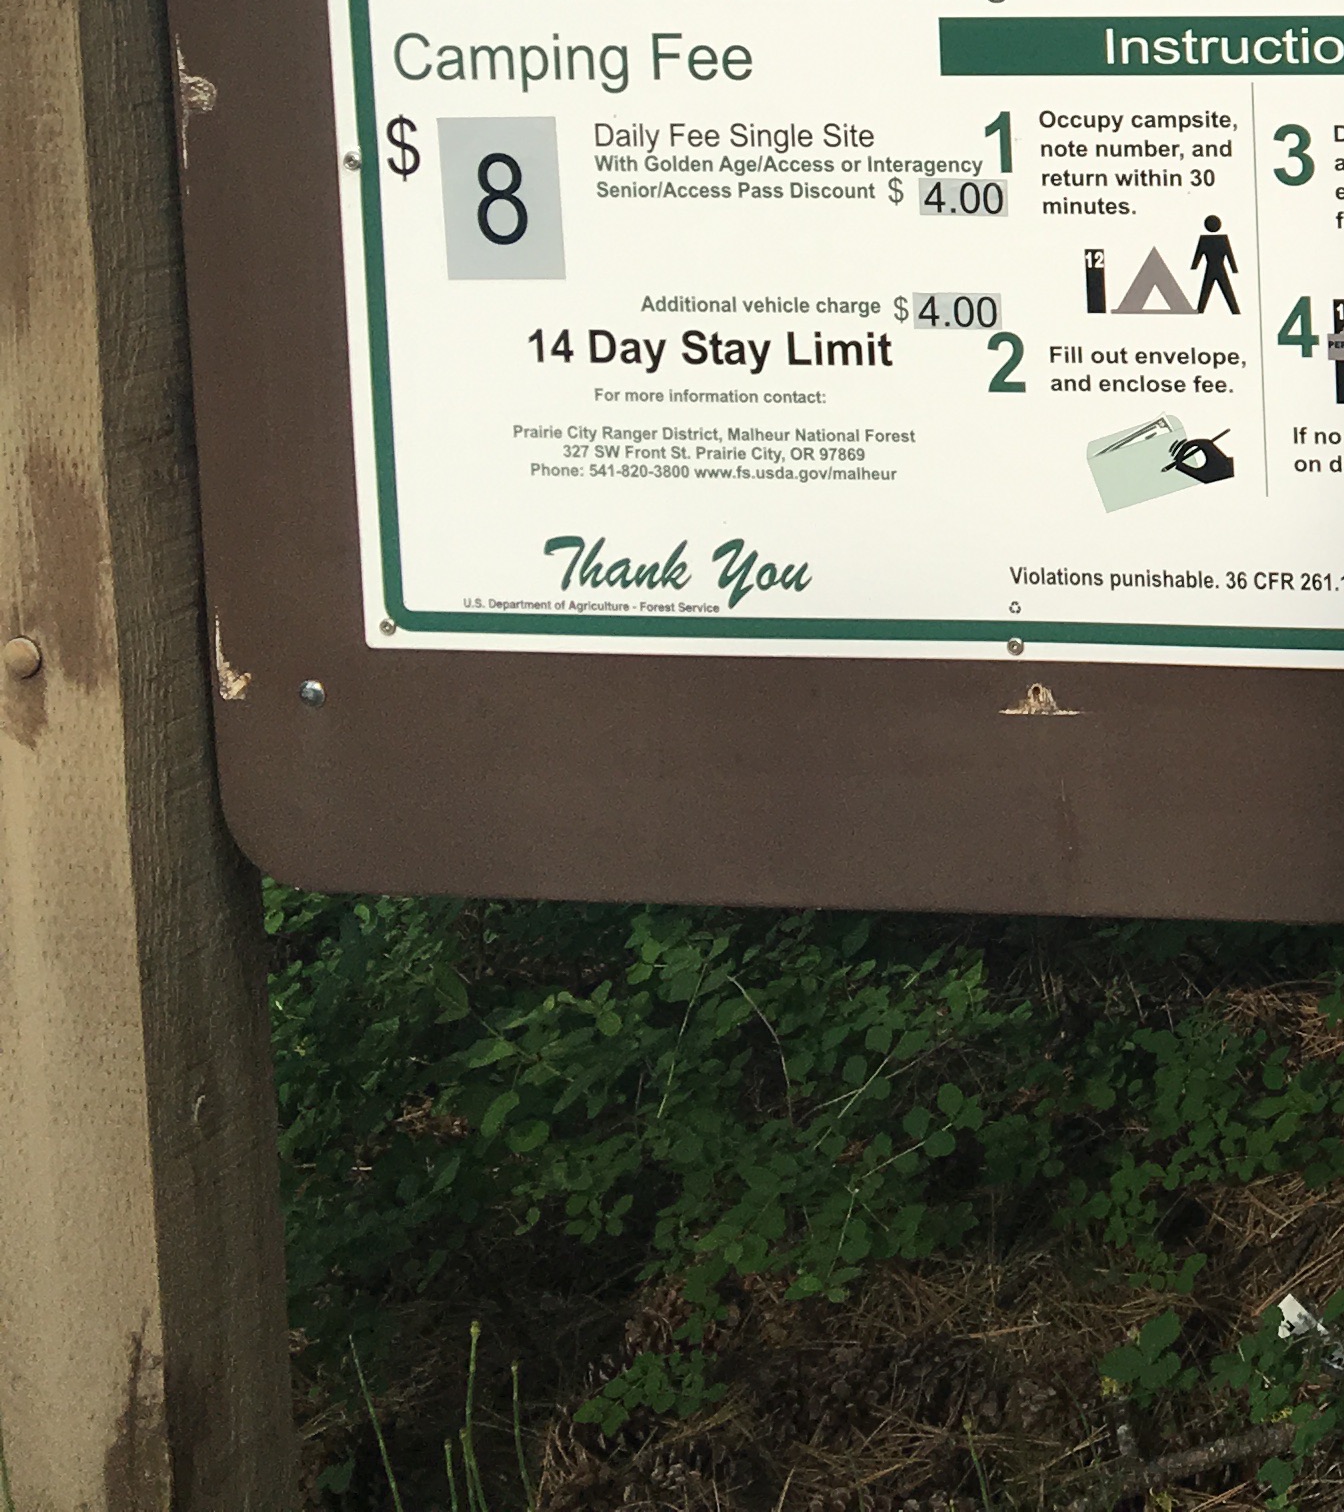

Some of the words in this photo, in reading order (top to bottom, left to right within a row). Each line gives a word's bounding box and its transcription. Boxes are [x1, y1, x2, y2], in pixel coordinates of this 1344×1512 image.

[393, 32, 629, 94] Camping
[651, 32, 753, 82] Fee
[1038, 109, 1124, 134] Occupy
[1130, 109, 1238, 133] campsite,
[385, 113, 421, 183] $
[984, 110, 1014, 174] 1
[1040, 140, 1089, 158] note
[1095, 139, 1185, 161] number,
[1191, 139, 1233, 158] and
[593, 154, 638, 172] With
[644, 154, 714, 173] Golden
[718, 154, 835, 177] Age/Access
[840, 159, 862, 173] or
[867, 155, 984, 180] Interagency
[1041, 169, 1108, 187] return
[1114, 168, 1183, 187] within
[1189, 168, 1216, 188] 30
[476, 152, 529, 246] 8
[596, 180, 733, 203] Senior/Access
[736, 180, 782, 200] Pass
[789, 180, 877, 200] Discount
[887, 177, 905, 206] $
[923, 182, 1004, 215] 4.00
[1042, 196, 1137, 216] minutes.
[1084, 249, 1105, 271] 12
[986, 331, 1027, 394] 2
[1049, 345, 1083, 364] Fill
[1090, 347, 1129, 365] out
[1134, 346, 1247, 370] envelope,
[594, 387, 621, 402] For
[624, 391, 665, 403] more
[668, 388, 759, 404] information
[763, 390, 827, 405] contact:
[1050, 373, 1092, 392] and
[1098, 374, 1187, 394] enclose
[1192, 374, 1234, 394] fee.
[512, 424, 563, 440] Prairie
[566, 425, 598, 443] City
[601, 425, 659, 444] Ranger
[661, 426, 723, 444] District,
[727, 427, 791, 442] Malheur
[795, 427, 860, 443] National
[864, 428, 917, 443] Forest
[562, 444, 590, 459] 327
[594, 444, 621, 459] SW
[624, 444, 667, 460] Front
[670, 445, 691, 460] St.
[695, 445, 747, 461] Prairie
[751, 446, 786, 465] City,
[789, 446, 816, 461] OR
[818, 446, 866, 462] 97869
[530, 462, 584, 478] Phone:
[589, 463, 690, 479] 541-820-3800
[693, 465, 898, 484] www.fs.usda.gov/malheur
[543, 535, 692, 592] Thank
[711, 538, 813, 609] You
